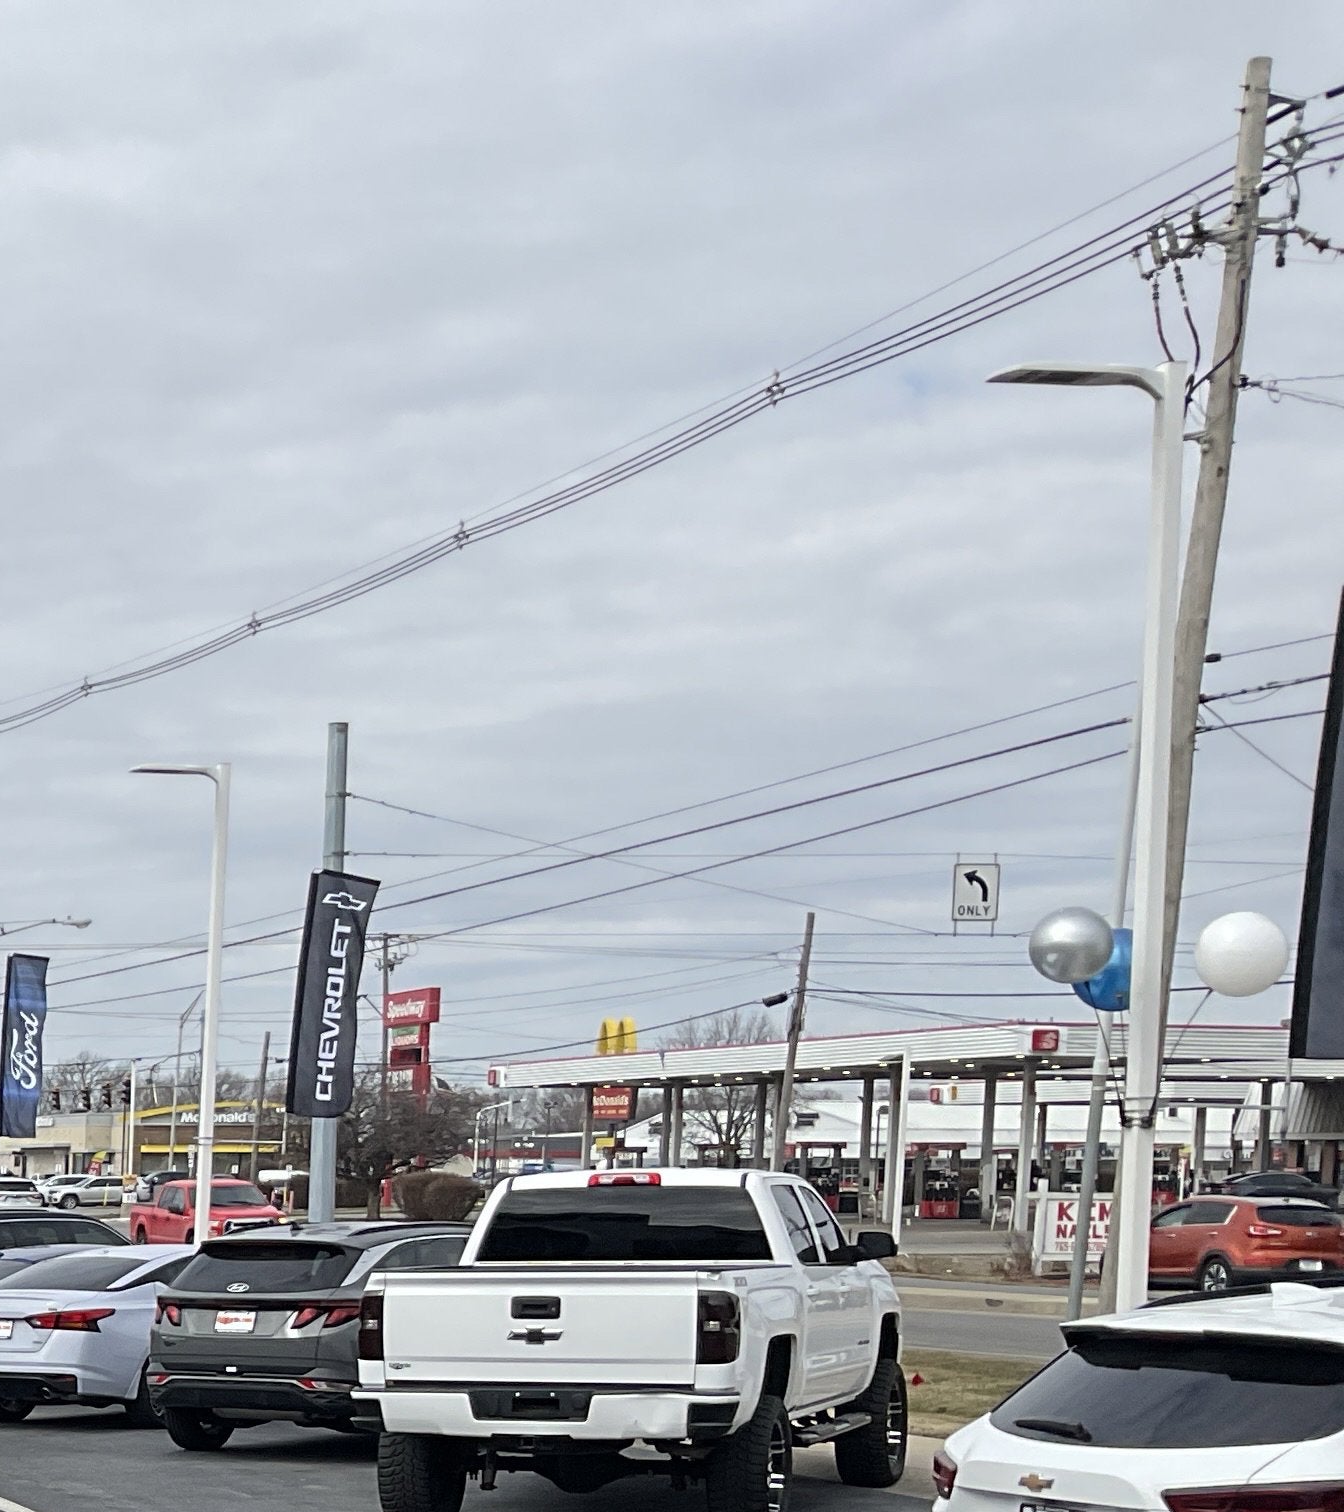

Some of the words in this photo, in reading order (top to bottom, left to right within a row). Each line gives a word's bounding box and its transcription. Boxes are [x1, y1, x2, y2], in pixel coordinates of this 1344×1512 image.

[957, 905, 992, 916] ONLY
[315, 918, 352, 1102] CHEVROLET
[10, 1011, 39, 1090] Ford
